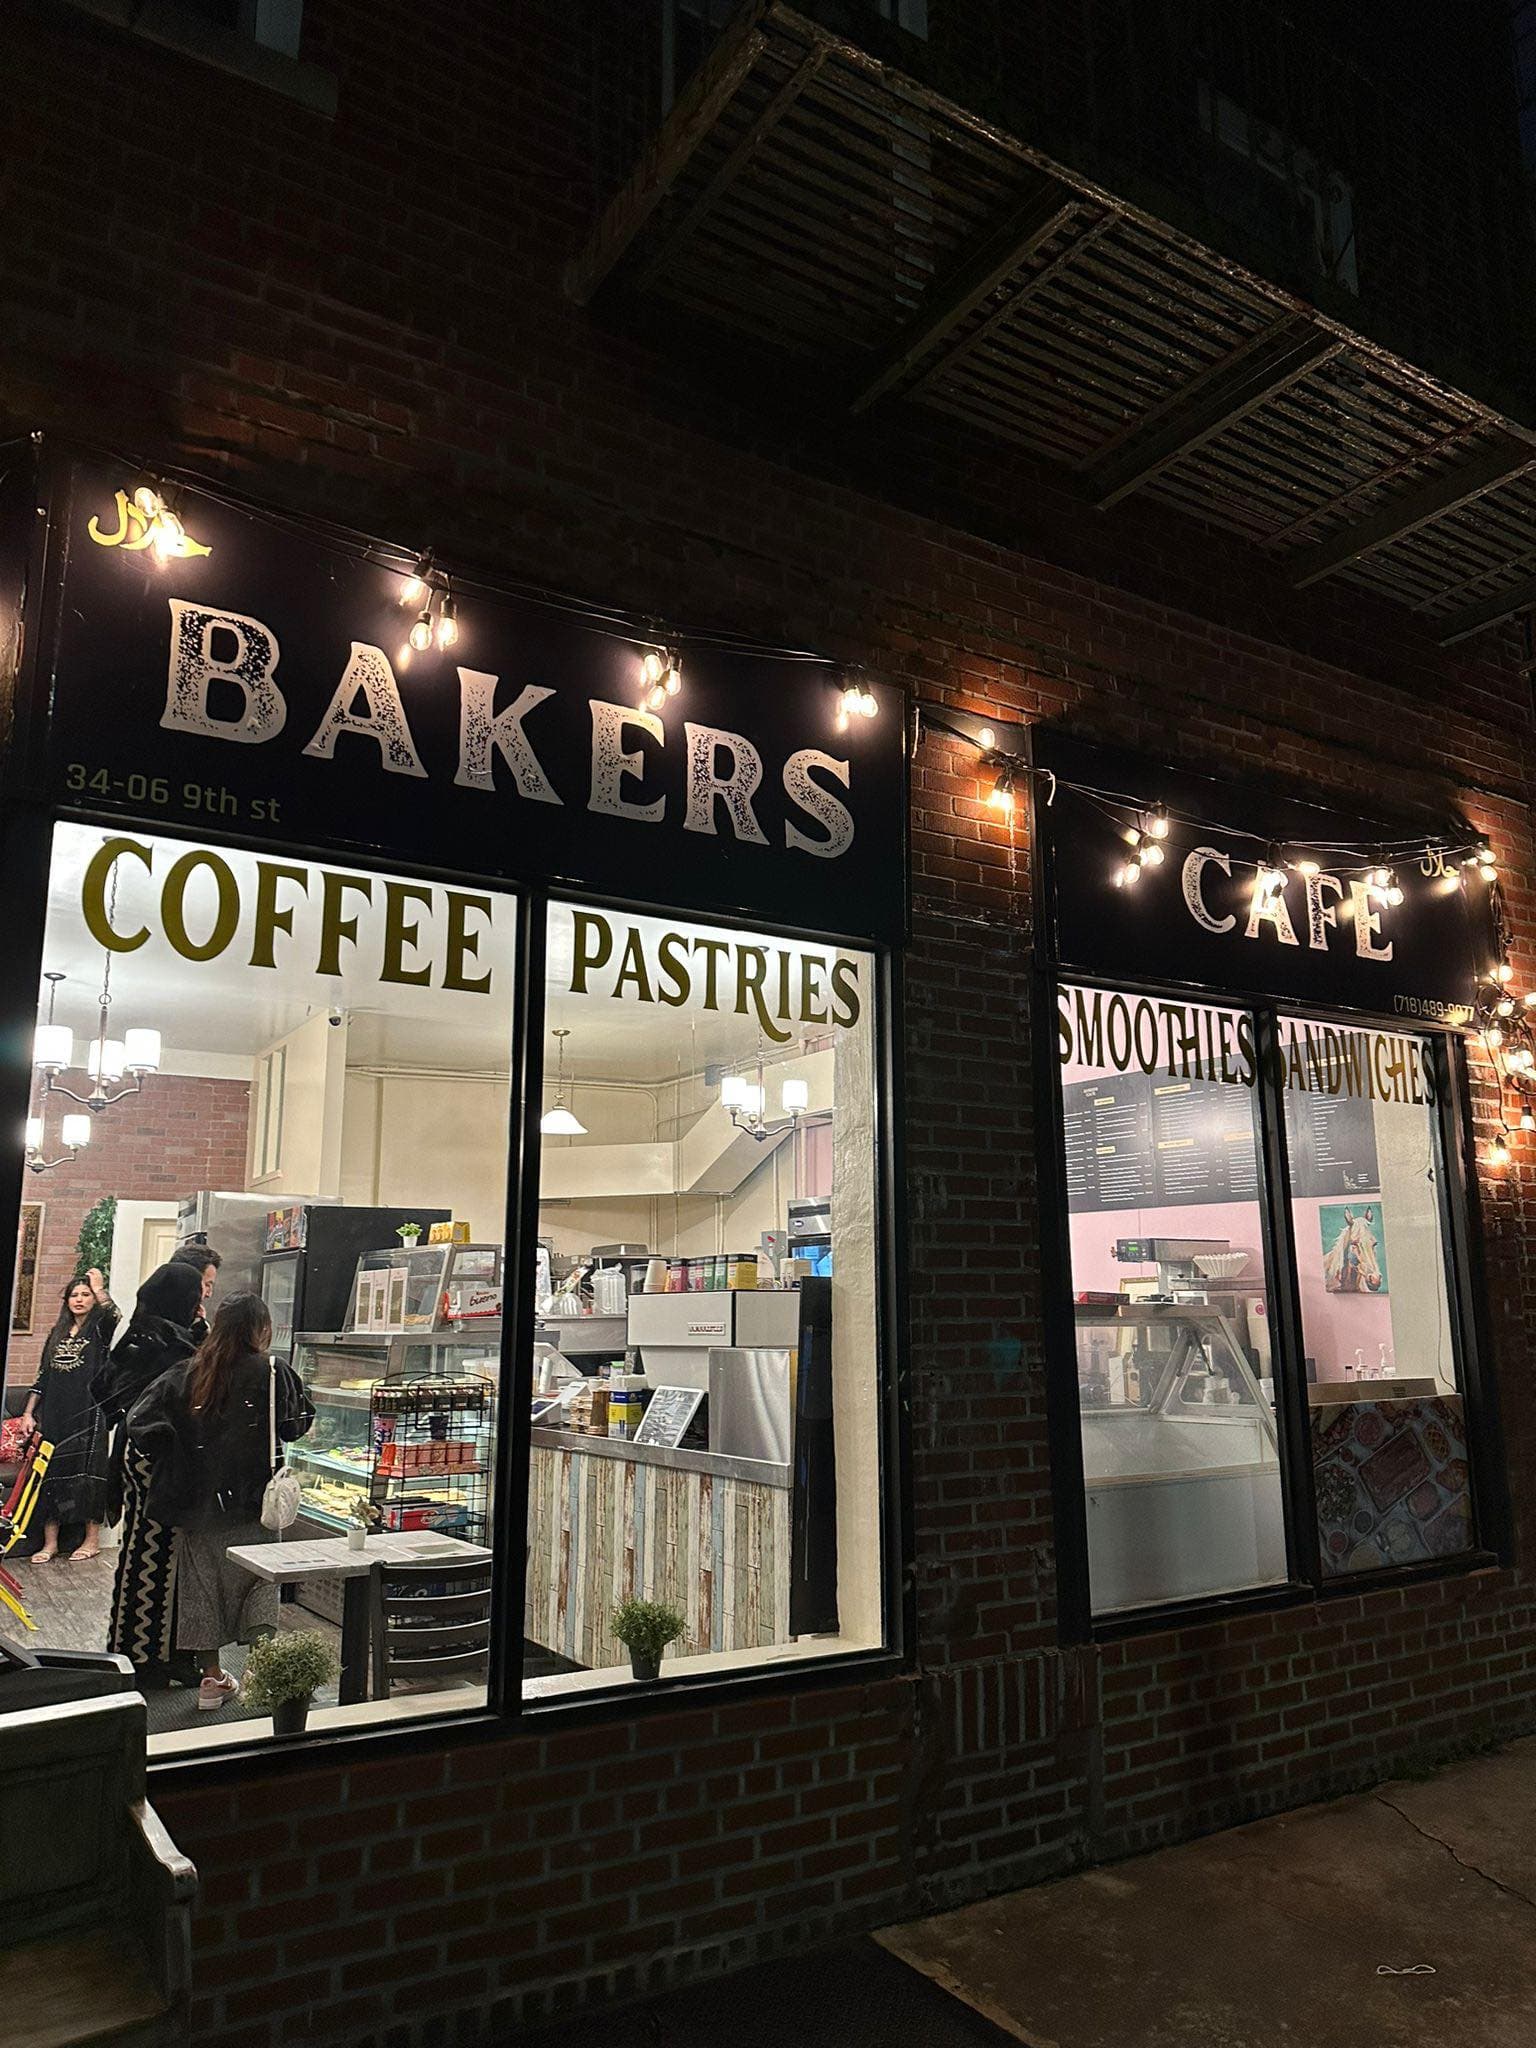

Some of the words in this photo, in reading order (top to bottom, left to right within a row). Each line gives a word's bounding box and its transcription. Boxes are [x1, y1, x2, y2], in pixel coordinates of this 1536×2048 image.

[159, 597, 856, 859] BAKERS
[66, 763, 170, 805] 34-06
[183, 783, 239, 816] 9th
[250, 798, 282, 823] st
[82, 836, 494, 995] COFFEE
[1181, 846, 1394, 962] CAFE
[568, 909, 861, 1043] PASTRIES
[1057, 984, 1257, 1088] SMOOTHIES
